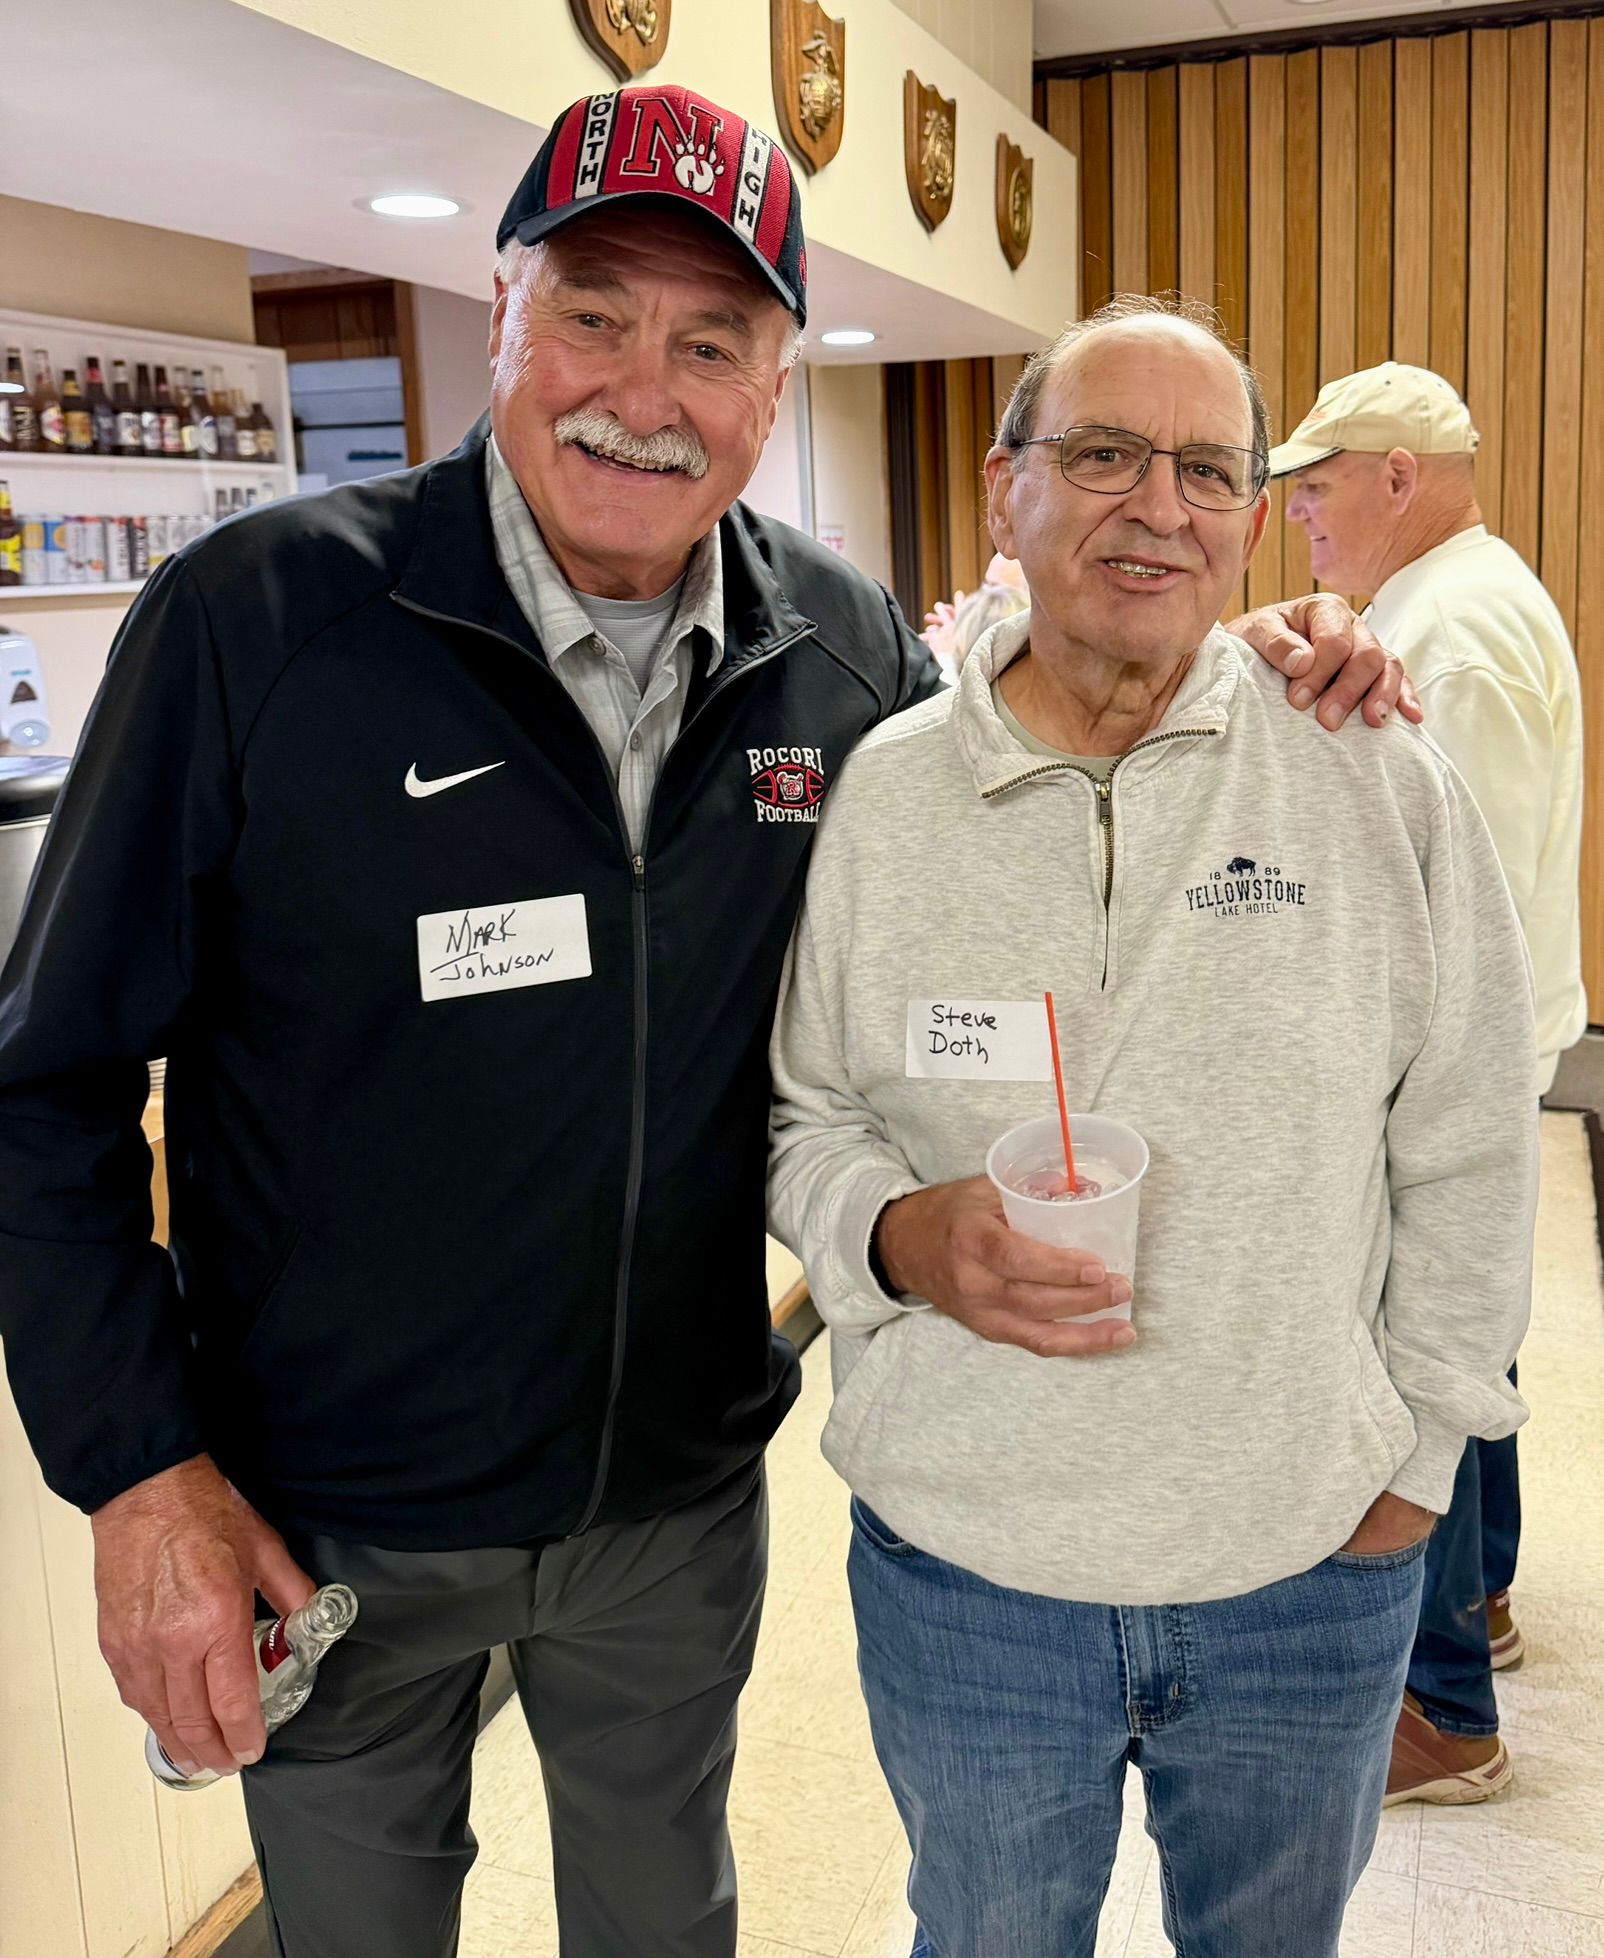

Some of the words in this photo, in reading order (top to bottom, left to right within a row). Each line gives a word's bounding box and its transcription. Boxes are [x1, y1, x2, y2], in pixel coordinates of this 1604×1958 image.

[738, 127, 767, 227] HIGH
[746, 747, 824, 776] ROCORI
[1209, 871, 1222, 880] 18
[1264, 867, 1281, 876] 89
[1186, 879, 1306, 911] YELLOWSTONE
[1215, 904, 1240, 917] LAKE
[1246, 902, 1279, 914] HOTEL
[931, 1004, 998, 1030] Steve
[928, 1029, 989, 1064] Doth
